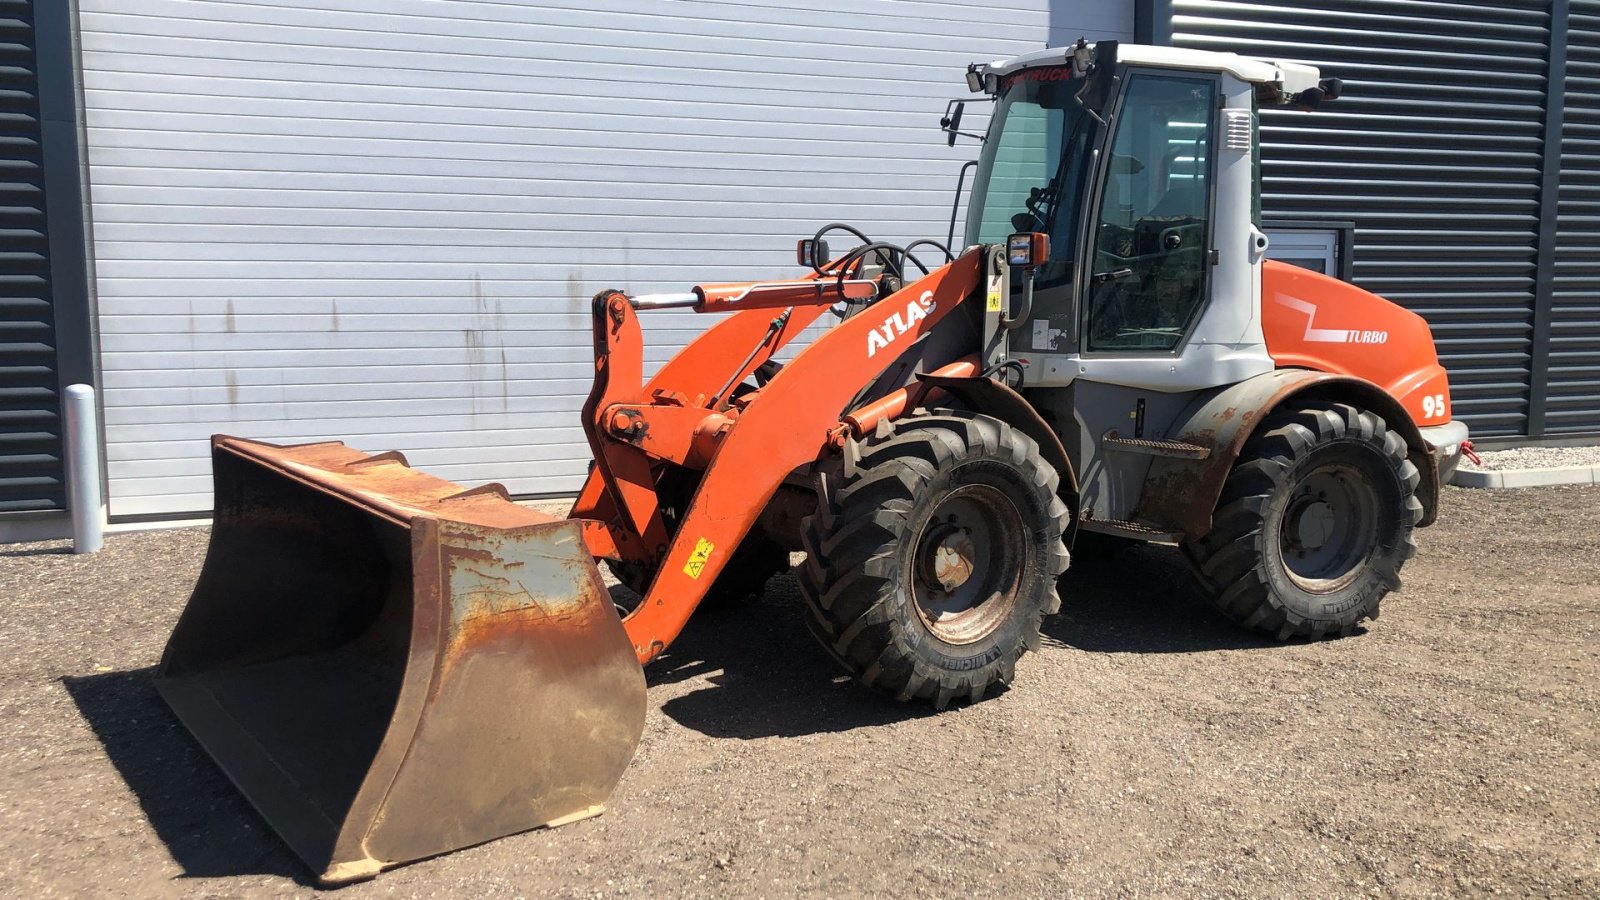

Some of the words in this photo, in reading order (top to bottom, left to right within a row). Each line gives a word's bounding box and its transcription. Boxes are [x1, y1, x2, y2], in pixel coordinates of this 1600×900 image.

[867, 289, 937, 359] ATLAS
[1347, 330, 1388, 344] TURBO
[1422, 394, 1446, 419] 95
